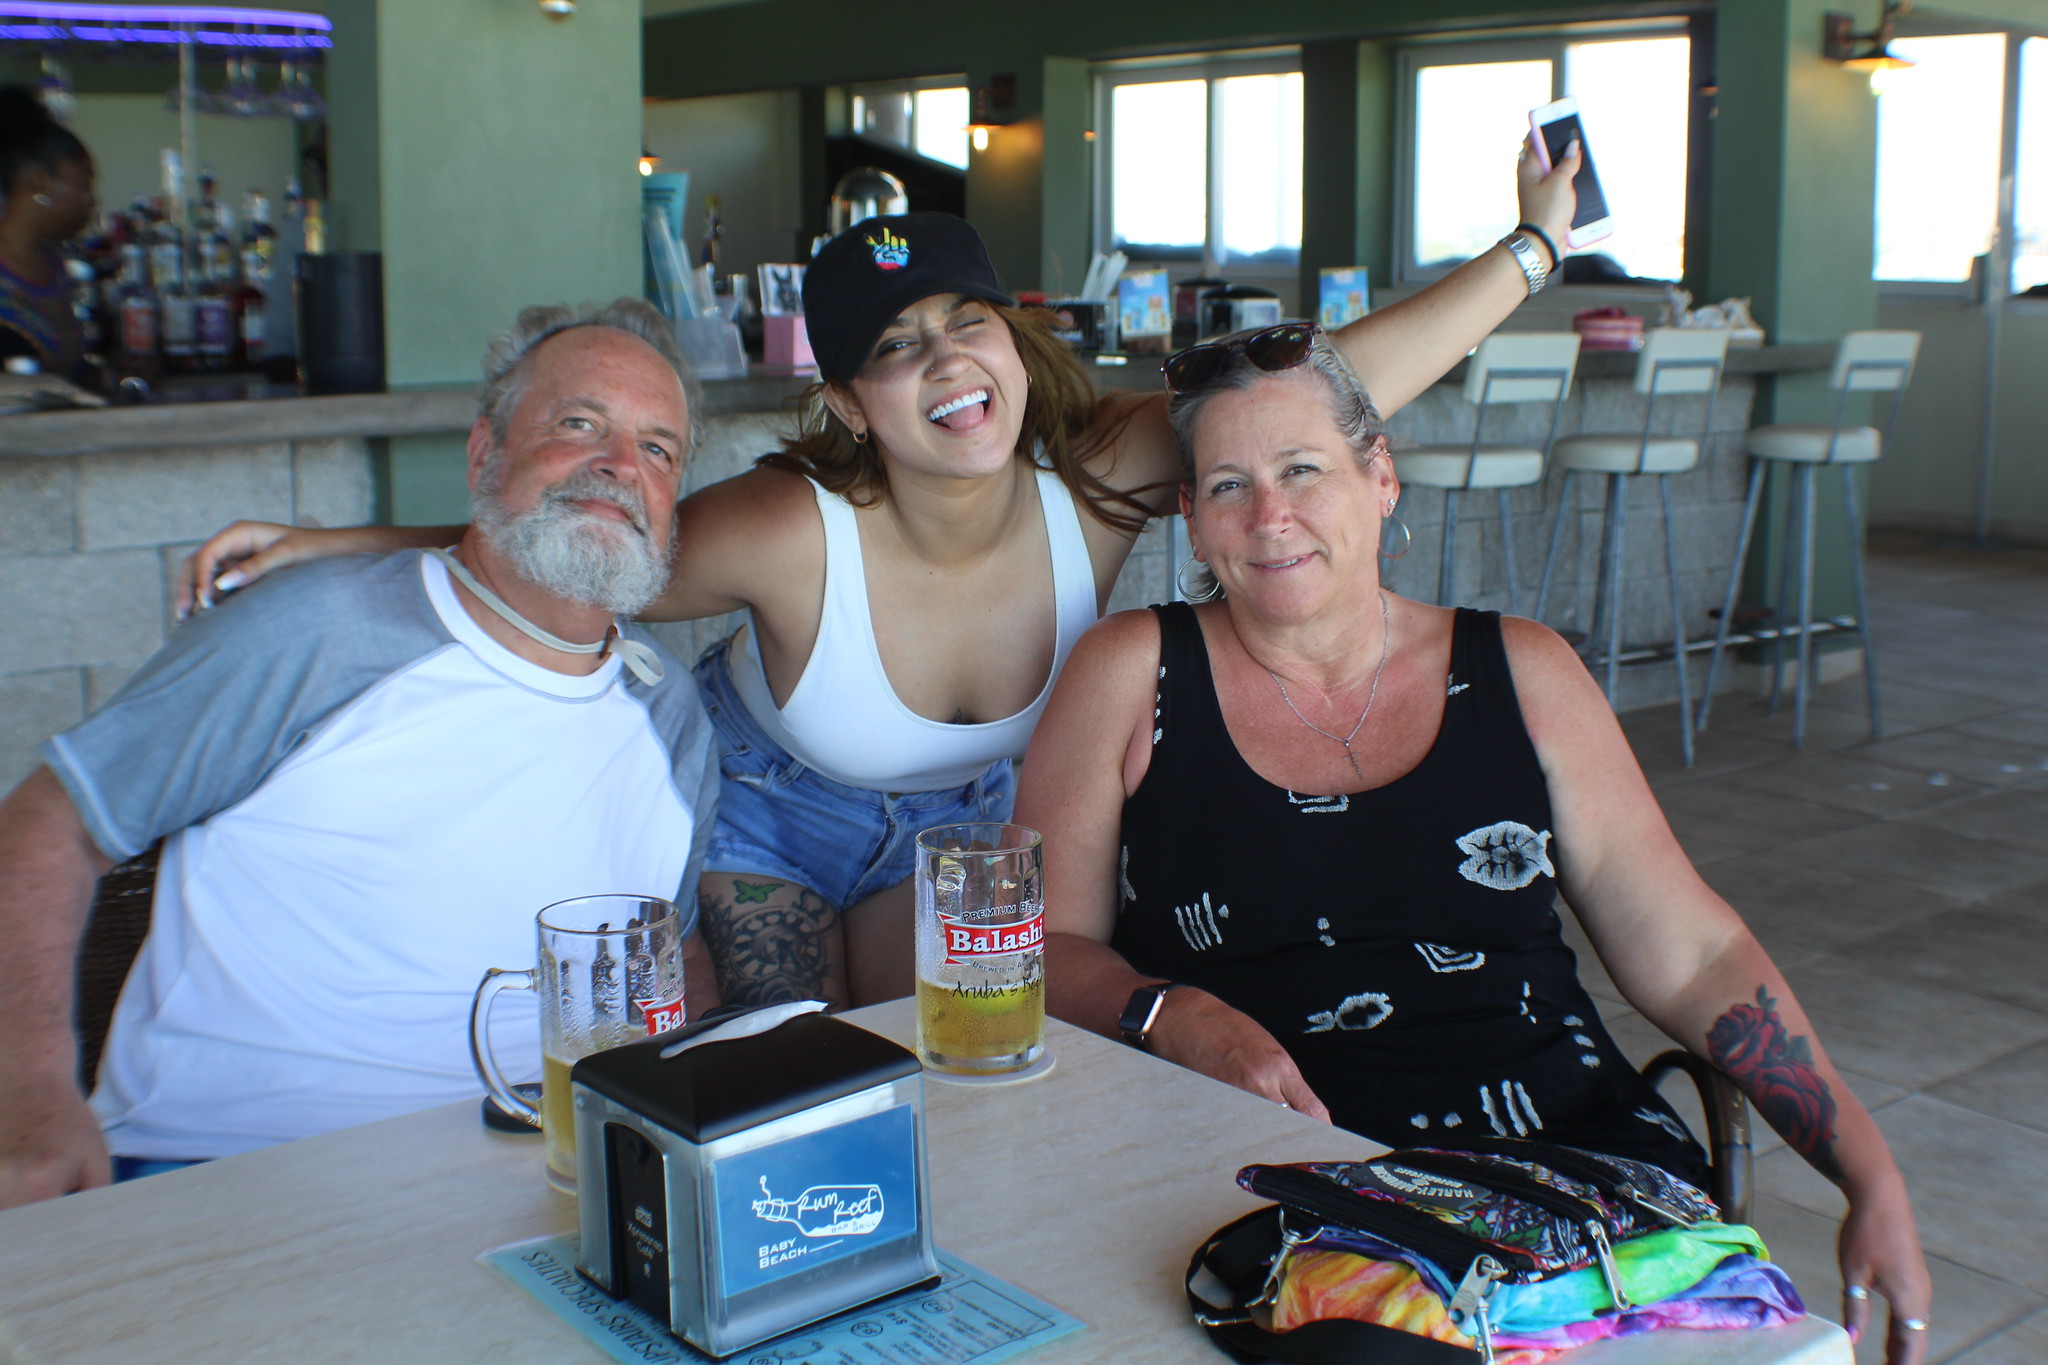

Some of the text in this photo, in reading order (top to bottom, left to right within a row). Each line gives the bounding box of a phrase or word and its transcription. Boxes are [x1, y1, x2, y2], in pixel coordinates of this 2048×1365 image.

[962, 904, 1017, 923] PREMIUM
[949, 917, 1044, 953] Balashi
[972, 960, 1006, 973] BREWED
[952, 980, 1018, 1000] Aruba's
[798, 1188, 878, 1225] Rum Reef
[831, 1223, 849, 1234] BAR
[852, 1220, 877, 1233] GRILL
[758, 1237, 797, 1258] BABY
[759, 1245, 807, 1269] BEACH
[521, 1251, 612, 1315] SPECIALTIES
